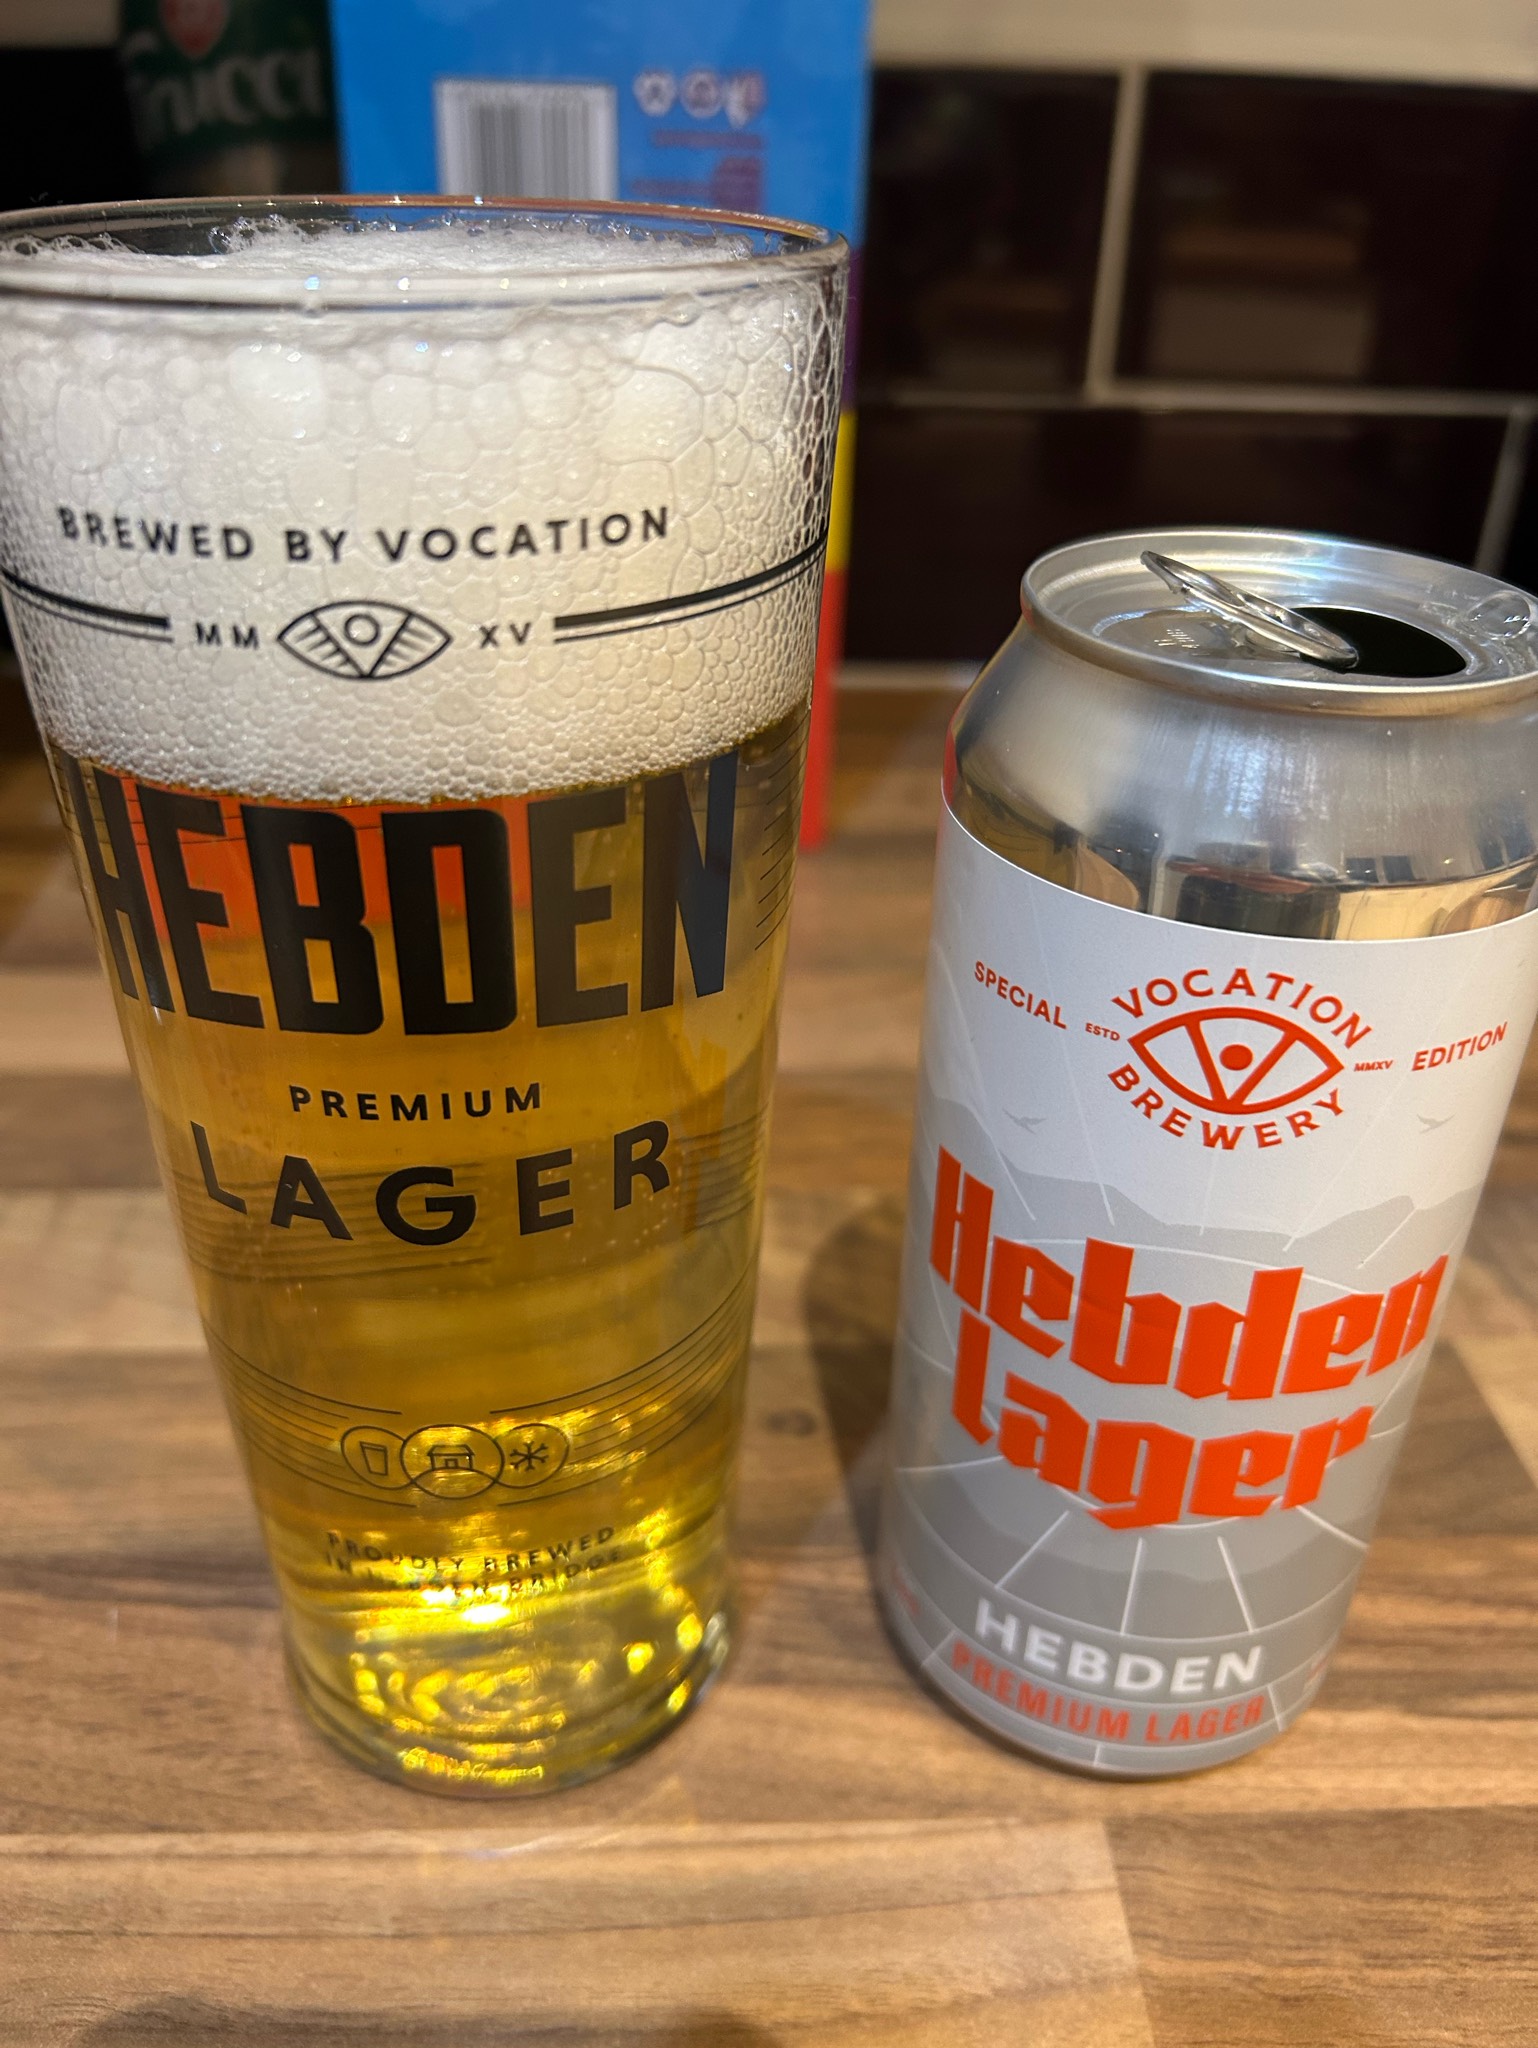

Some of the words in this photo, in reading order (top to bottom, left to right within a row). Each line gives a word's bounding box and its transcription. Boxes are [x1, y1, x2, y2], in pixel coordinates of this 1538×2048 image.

[59, 506, 254, 560] BREWED
[286, 528, 348, 563] BY
[375, 506, 670, 563] VOCATION
[196, 622, 260, 650] MM
[478, 622, 533, 649] XV
[53, 746, 740, 1035] HEBDEN
[974, 960, 1067, 1030] SPECIAL
[1111, 967, 1373, 1050] VOCATION
[1084, 1021, 1121, 1042] ESTD
[1354, 1059, 1394, 1074] MMXV
[1411, 1021, 1509, 1072] EDITION
[289, 1083, 542, 1122] PREMIUM
[1107, 1062, 1345, 1151] BREWERY
[190, 1120, 670, 1246] LAGER
[929, 1144, 1449, 1401] Hebden
[483, 1525, 615, 1572] BREWED
[974, 1598, 1266, 1695] HEBDEN
[951, 1640, 1131, 1742] PREMIUM
[1144, 1695, 1266, 1743] LAGER
